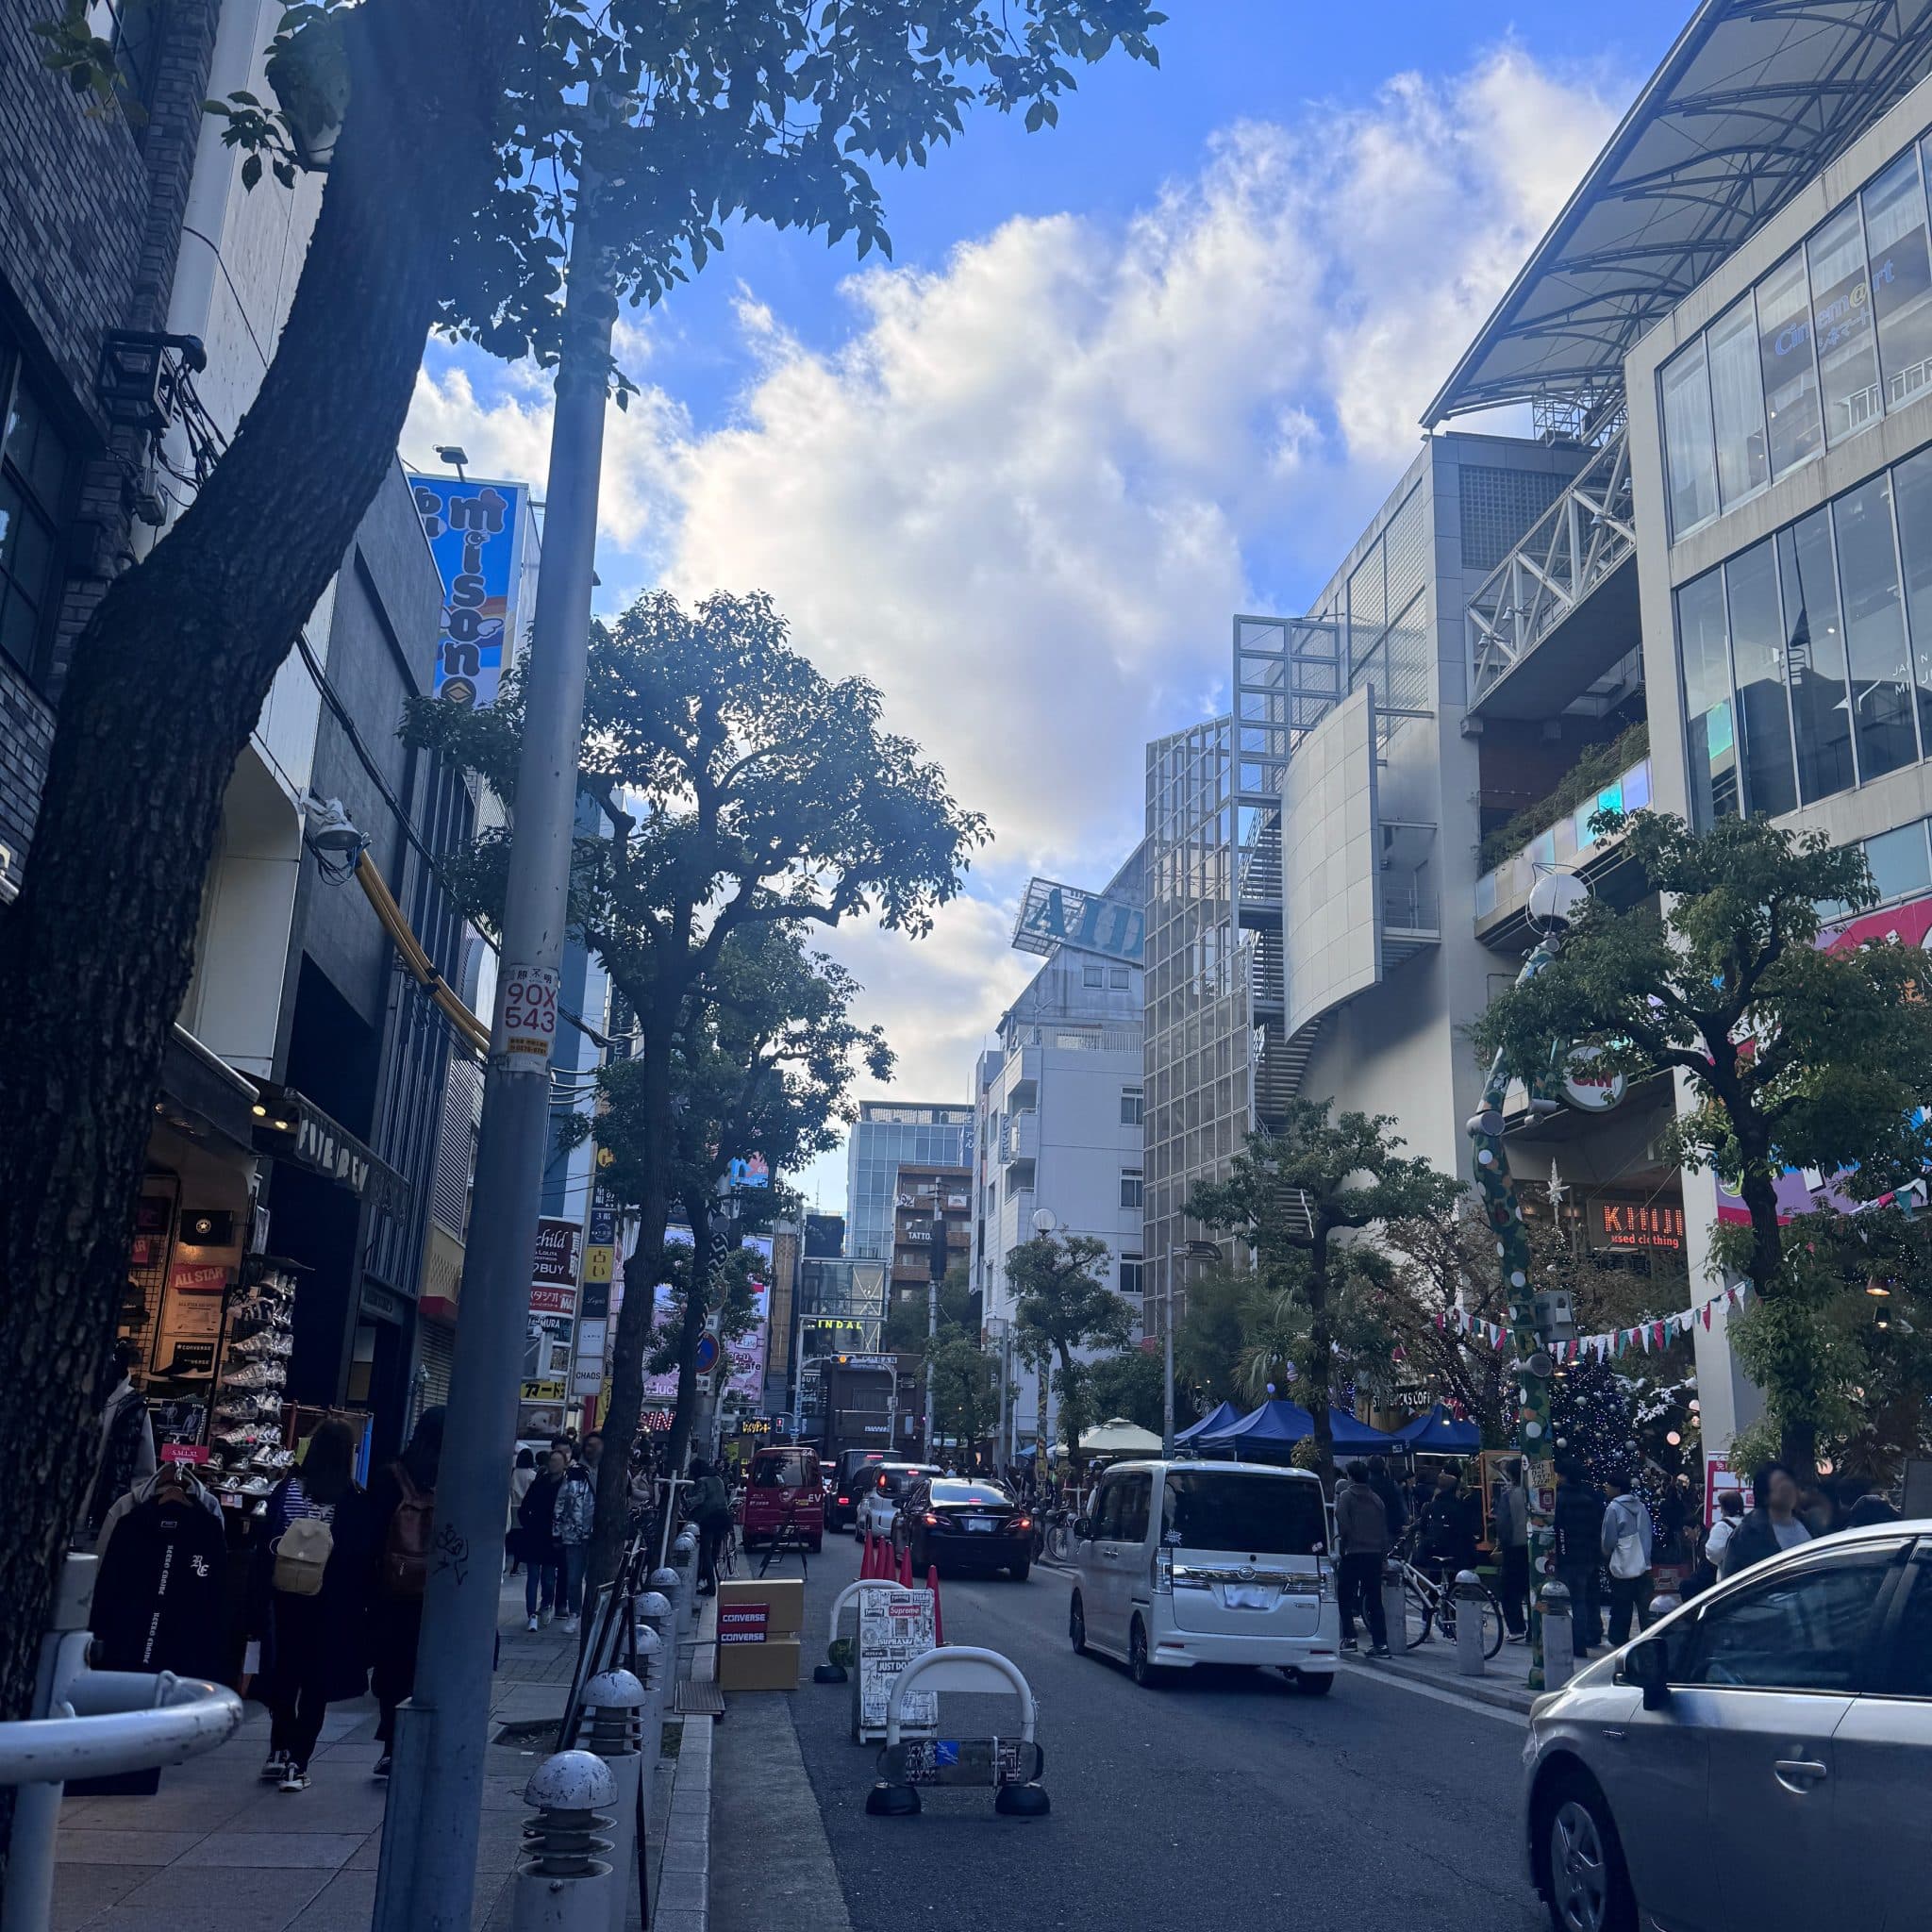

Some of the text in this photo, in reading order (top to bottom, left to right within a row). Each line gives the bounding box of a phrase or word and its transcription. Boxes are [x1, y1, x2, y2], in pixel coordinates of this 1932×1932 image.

[508, 982, 558, 1010] 90X
[505, 1007, 556, 1033] 543
[908, 1231, 933, 1241] TATTO
[1611, 1234, 1636, 1243] used
[175, 1266, 225, 1287] ALL STAR
[575, 1371, 601, 1380] CHAOS
[808, 1493, 822, 1502] EV
[890, 1607, 920, 1616] Supreme
[723, 1613, 766, 1623] CONVERSE
[721, 1632, 765, 1642] CONVERSE
[878, 1660, 895, 1672] JUST
